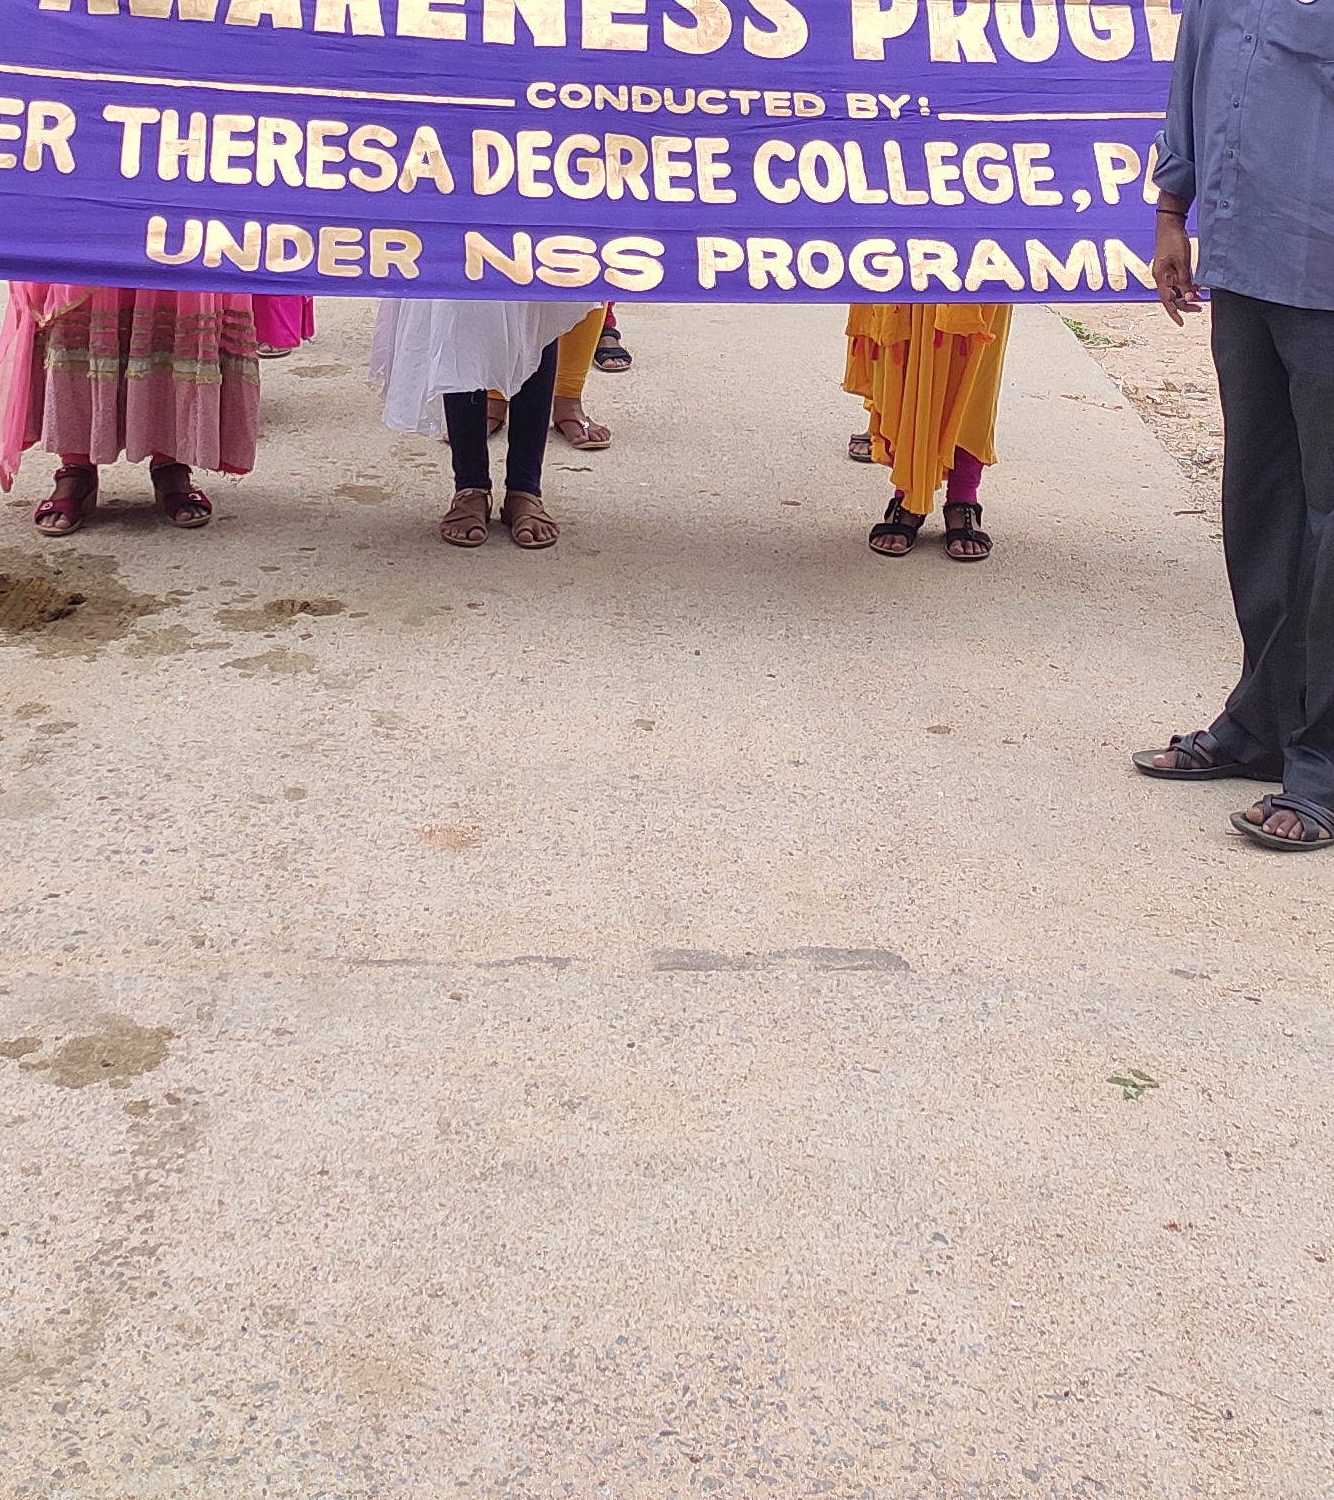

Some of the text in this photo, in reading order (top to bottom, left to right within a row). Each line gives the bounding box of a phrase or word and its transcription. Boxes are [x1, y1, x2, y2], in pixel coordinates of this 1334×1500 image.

[526, 81, 931, 120] CONDUCTED BY:
[102, 104, 455, 195] THERESA
[472, 129, 736, 204] DEGREE
[146, 214, 1200, 293] UNDER NSS PROGRAMM
